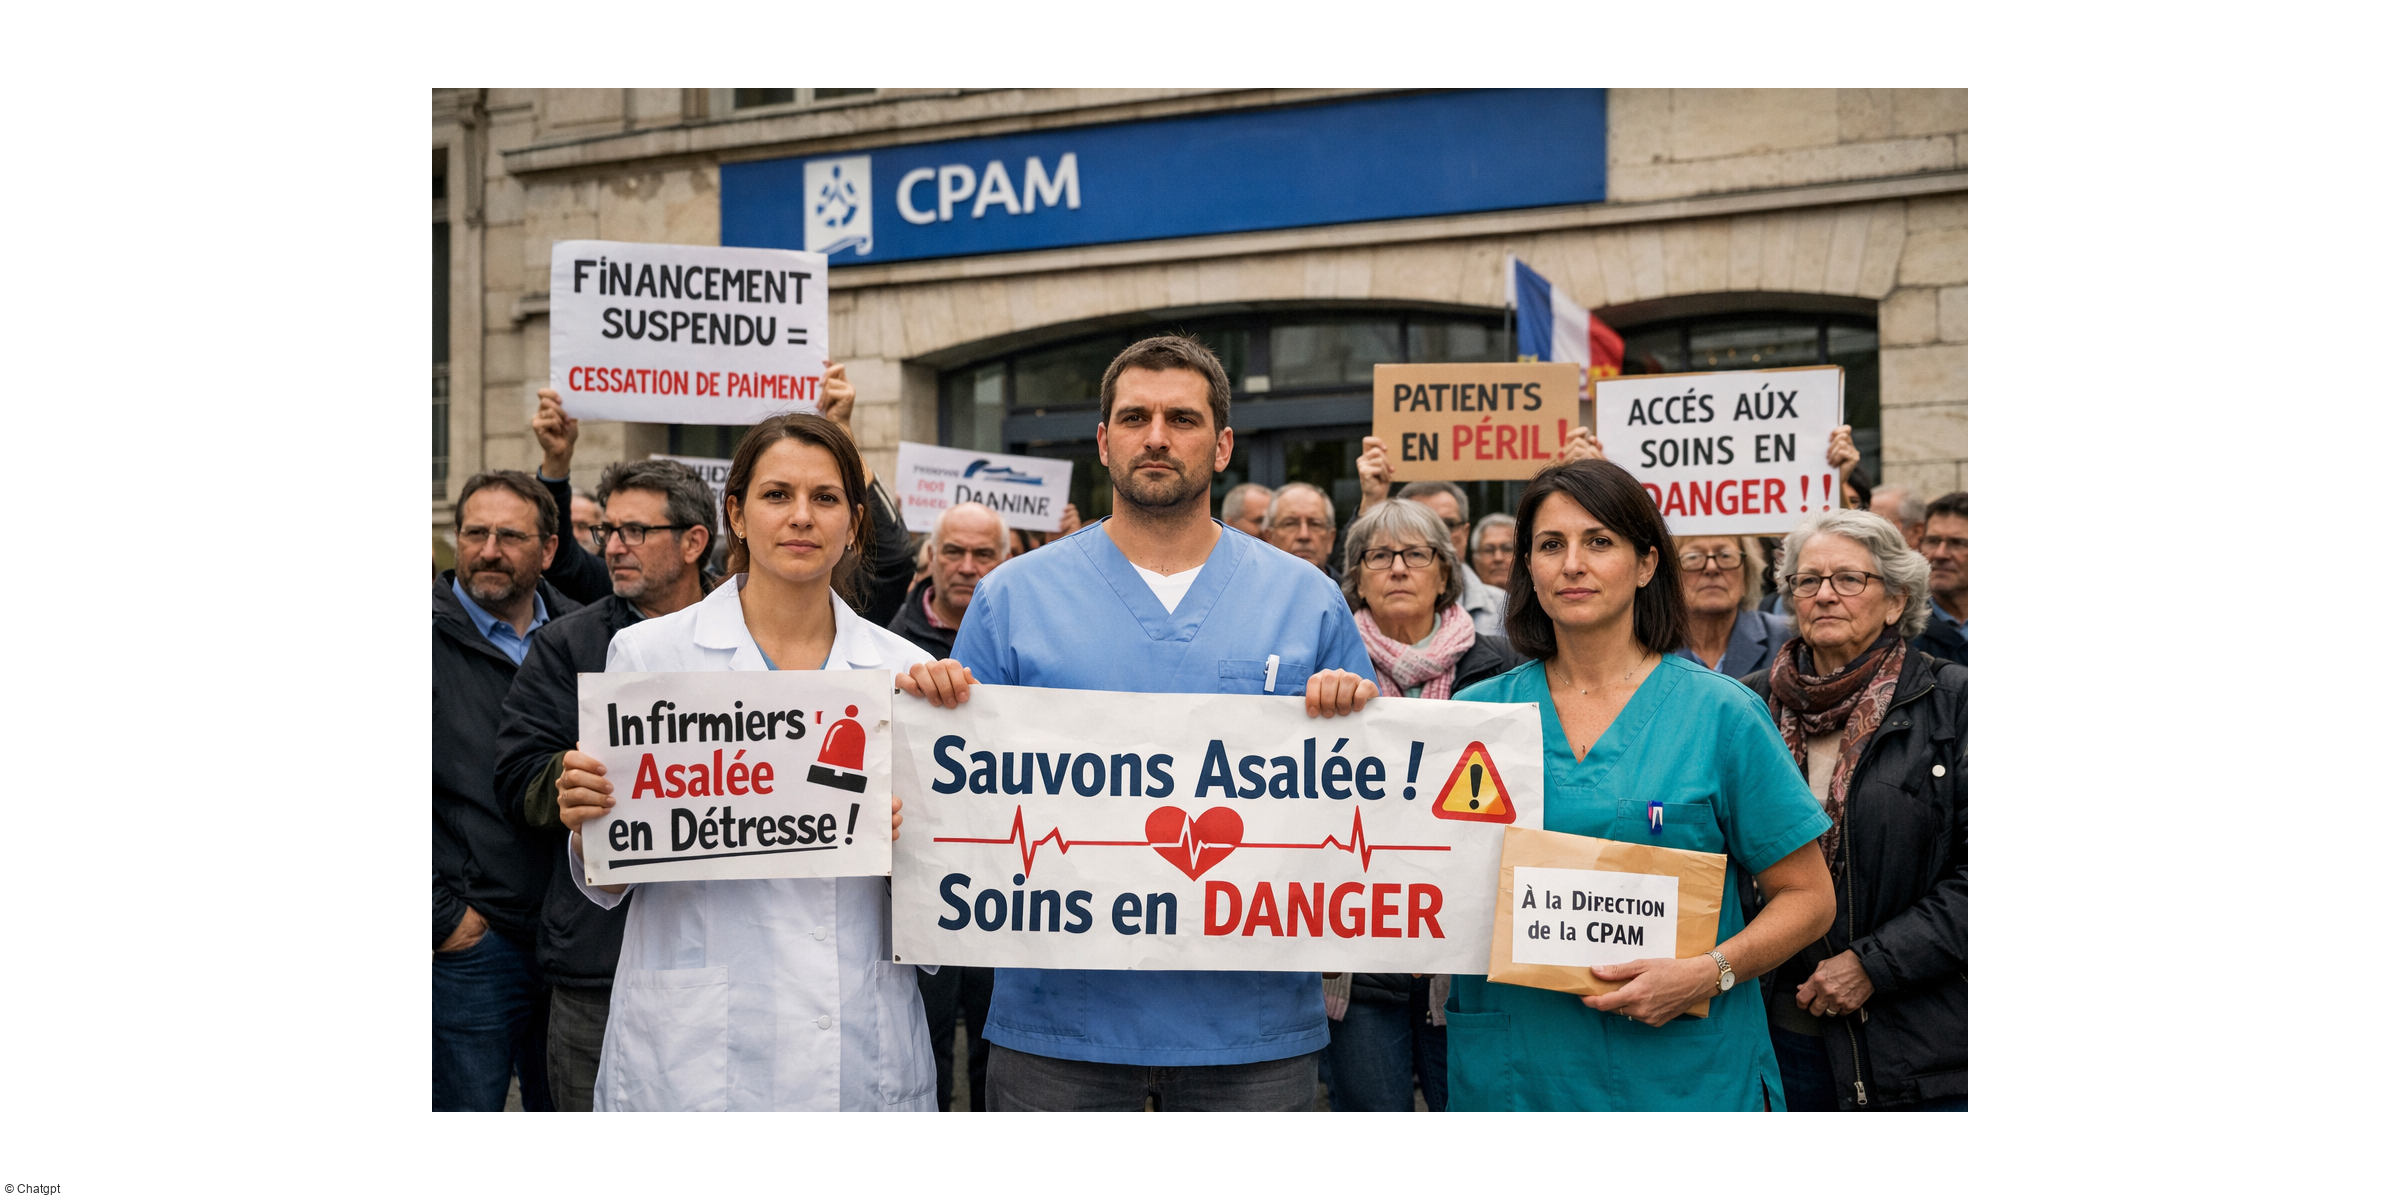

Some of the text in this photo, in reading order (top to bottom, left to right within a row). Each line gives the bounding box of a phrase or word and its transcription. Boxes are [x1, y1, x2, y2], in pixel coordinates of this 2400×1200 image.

[898, 154, 1079, 223] CPAM
[602, 308, 776, 346] SUSPENDU
[569, 367, 688, 395] CESSATION
[697, 372, 720, 396] DE
[1394, 383, 1542, 412] PATIENTS
[1628, 388, 1714, 425] ACCÉS
[1402, 433, 1438, 461] EN
[1641, 434, 1795, 468] SOINS EN
[608, 700, 805, 747] Infirmiers
[632, 749, 774, 799] Asalée
[932, 735, 1174, 798] Sauvons
[1195, 737, 1385, 800] Asalée
[609, 820, 653, 851] en
[938, 873, 1445, 938] Soins en DANGER
[1522, 884, 1536, 908] À
[1546, 891, 1561, 909] la
[1528, 921, 1643, 946] de la CPAM
